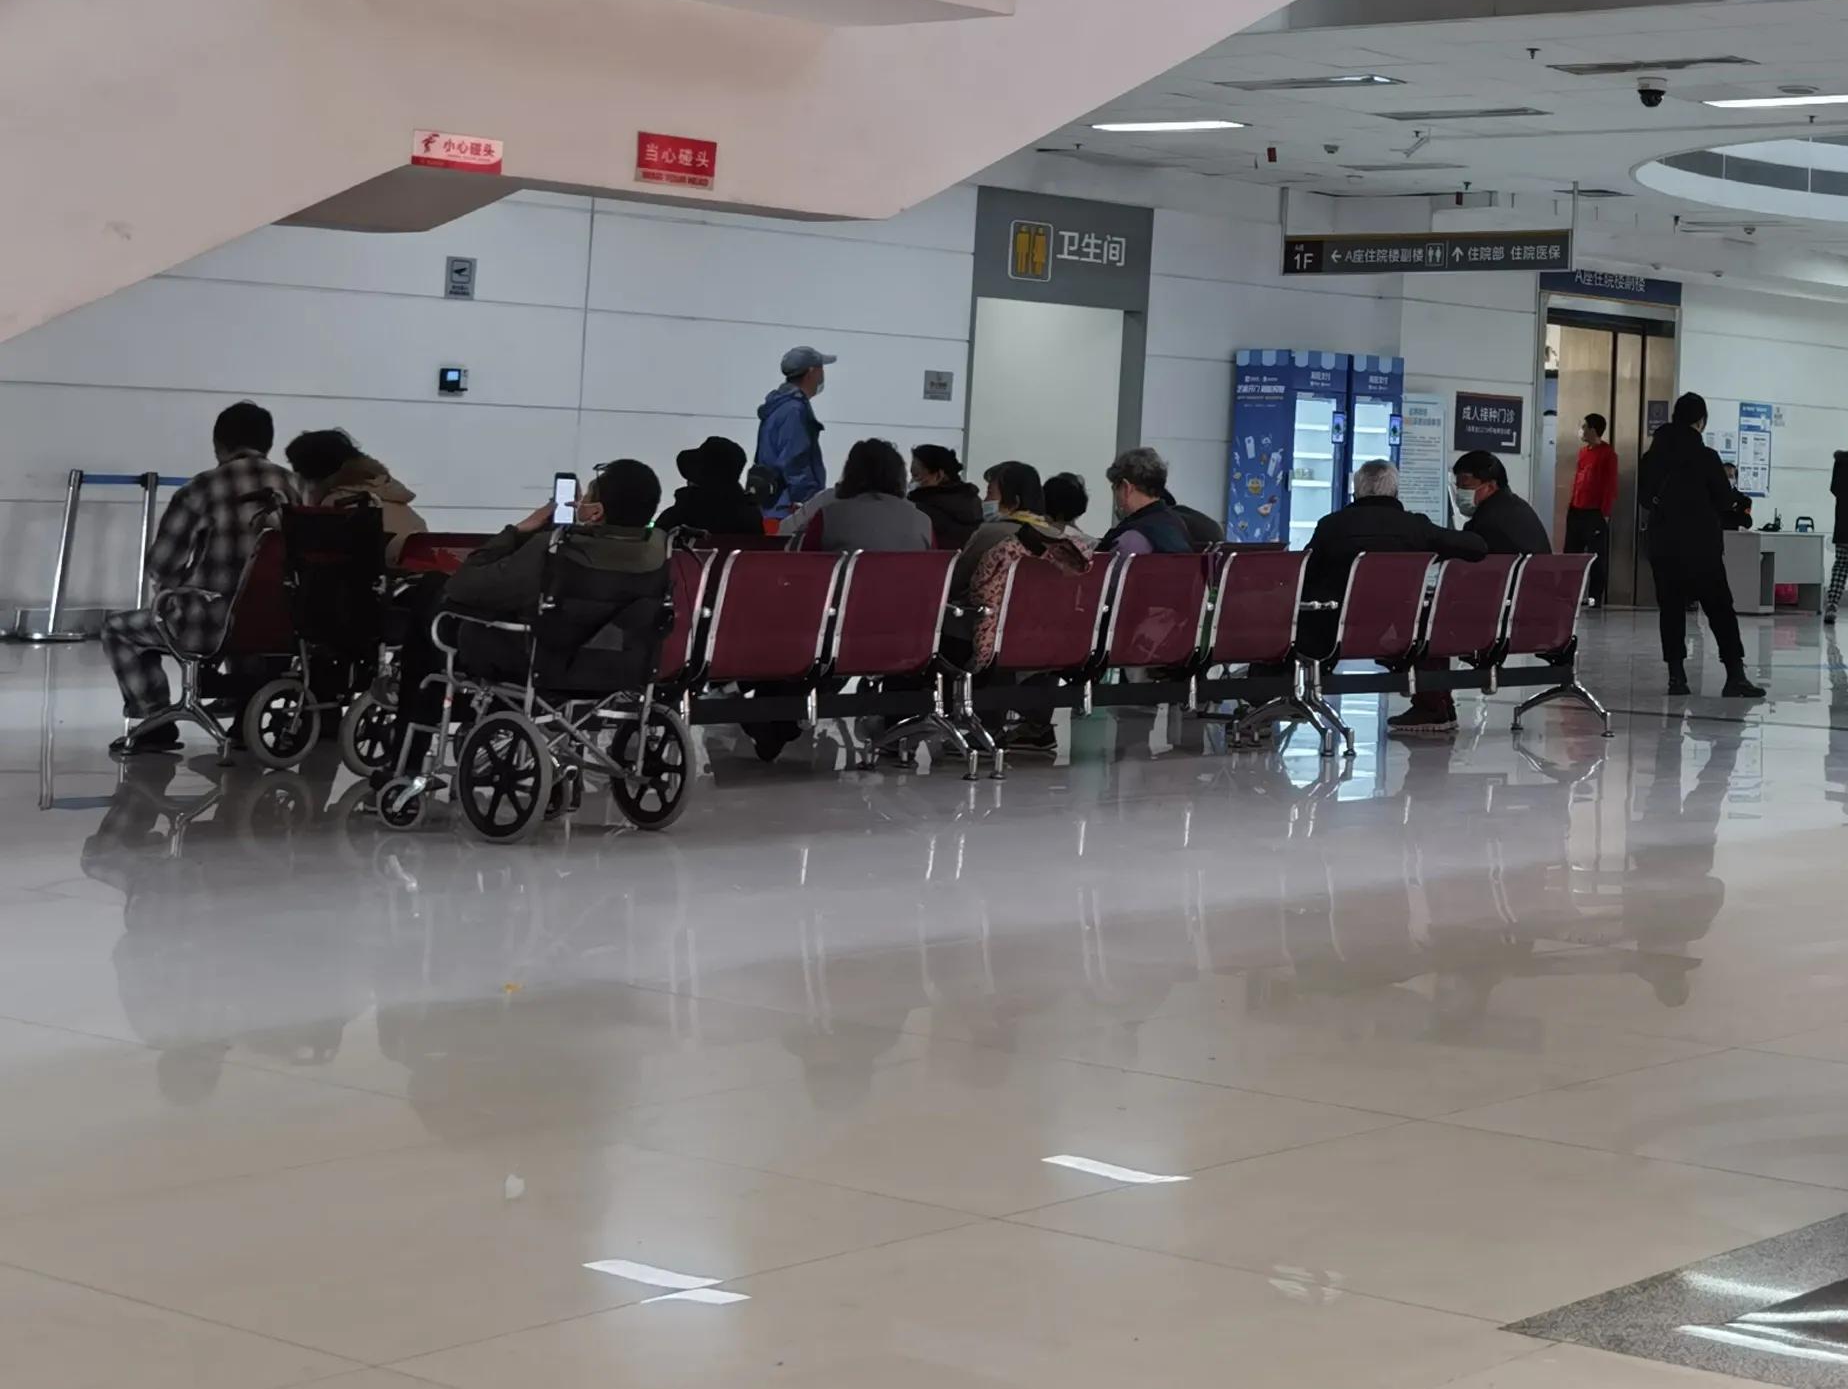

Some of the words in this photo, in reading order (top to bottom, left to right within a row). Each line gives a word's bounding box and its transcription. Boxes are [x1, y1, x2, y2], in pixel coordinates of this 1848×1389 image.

[645, 143, 709, 168] 当心碰头
[1056, 231, 1126, 267] 卫生间
[1468, 246, 1505, 261] 住院部
[1511, 245, 1561, 260] 住院医保
[1293, 253, 1314, 271] 1F
